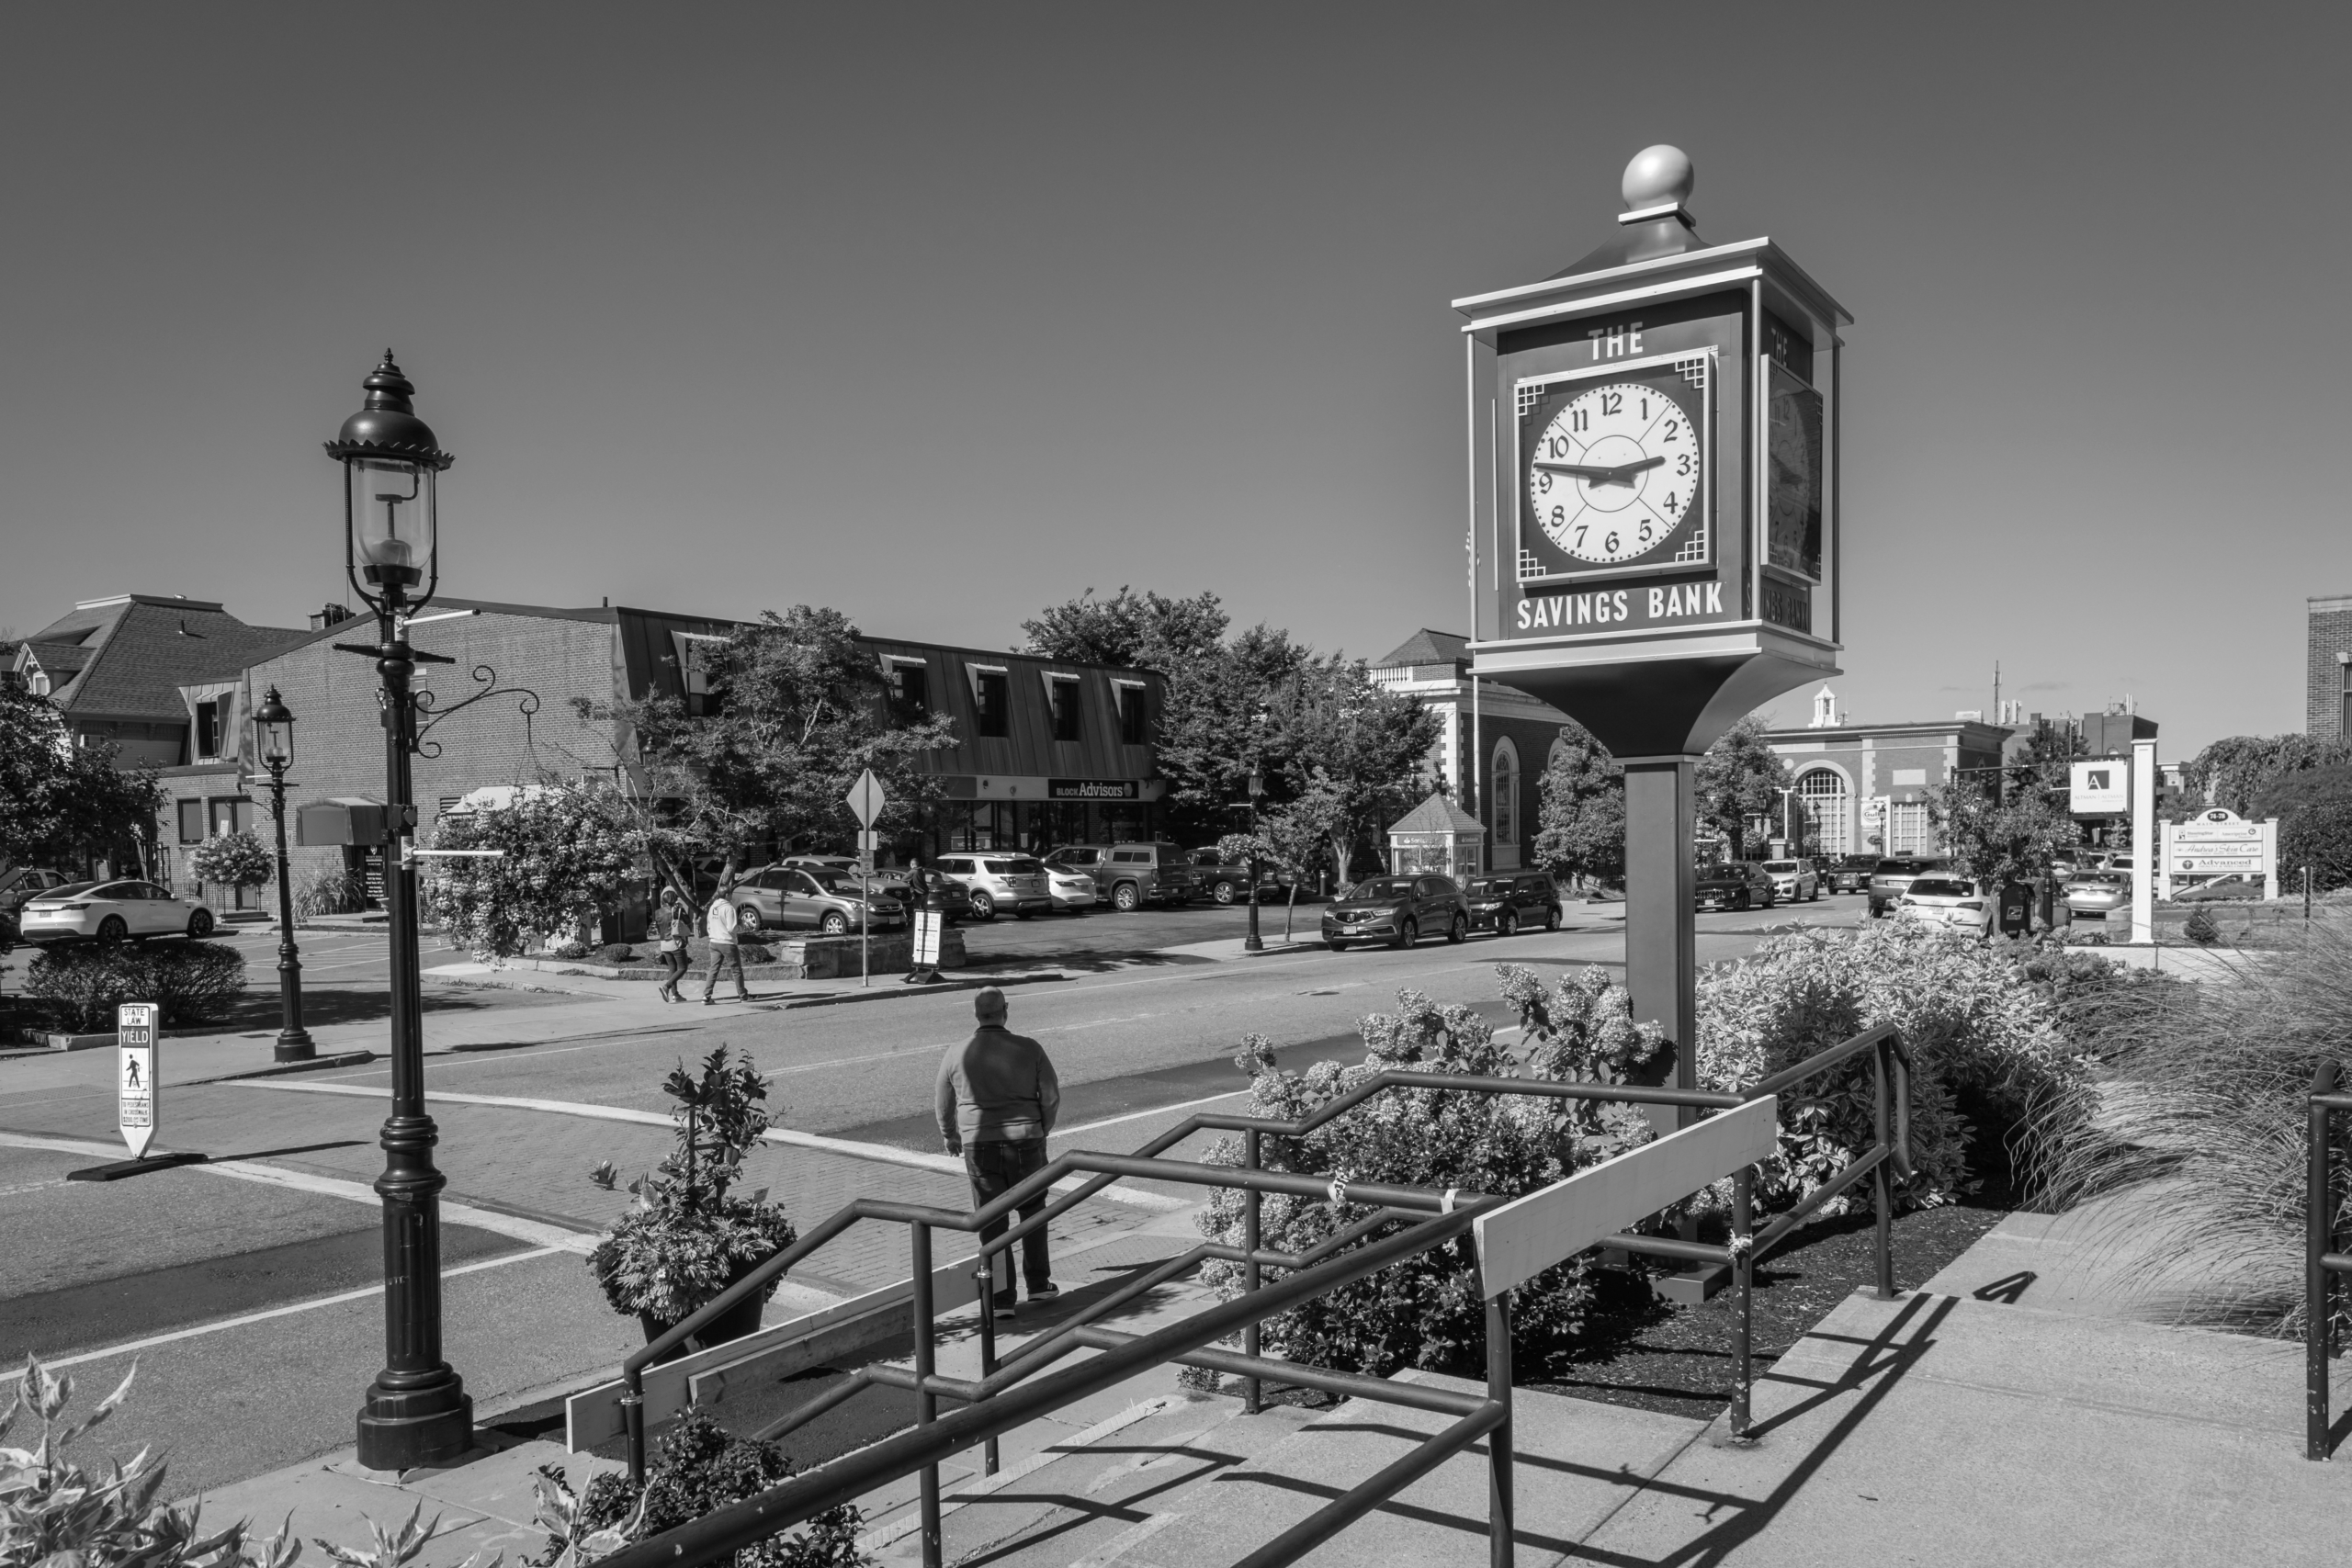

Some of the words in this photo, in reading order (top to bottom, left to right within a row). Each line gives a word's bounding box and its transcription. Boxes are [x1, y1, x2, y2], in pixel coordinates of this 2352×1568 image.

[1588, 321, 1644, 360] THE
[1600, 392, 1623, 417] 12
[1640, 398, 1648, 421] 1
[1571, 409, 1589, 433] 11
[1663, 419, 1679, 443] 2
[1547, 434, 1569, 459] 10
[1676, 454, 1690, 477] 3
[1539, 471, 1553, 494] 9
[1663, 491, 1679, 514] 4
[1551, 505, 1565, 527] 8
[1575, 525, 1589, 548] 7
[1638, 519, 1652, 542] 5
[1605, 531, 1620, 554] 6
[1517, 590, 1629, 630] SAVINGS
[1649, 581, 1723, 618] BANK
[1787, 596, 1808, 632] BANK
[1057, 787, 1079, 795] BLOCK
[1079, 782, 1123, 796] Advisors
[2185, 844, 2218, 852] Andrea's
[2218, 843, 2239, 852] Skin
[2239, 843, 2259, 852] Care
[124, 1009, 145, 1017] STATE
[127, 1017, 141, 1025] LAW
[121, 1031, 149, 1043] YIELD
